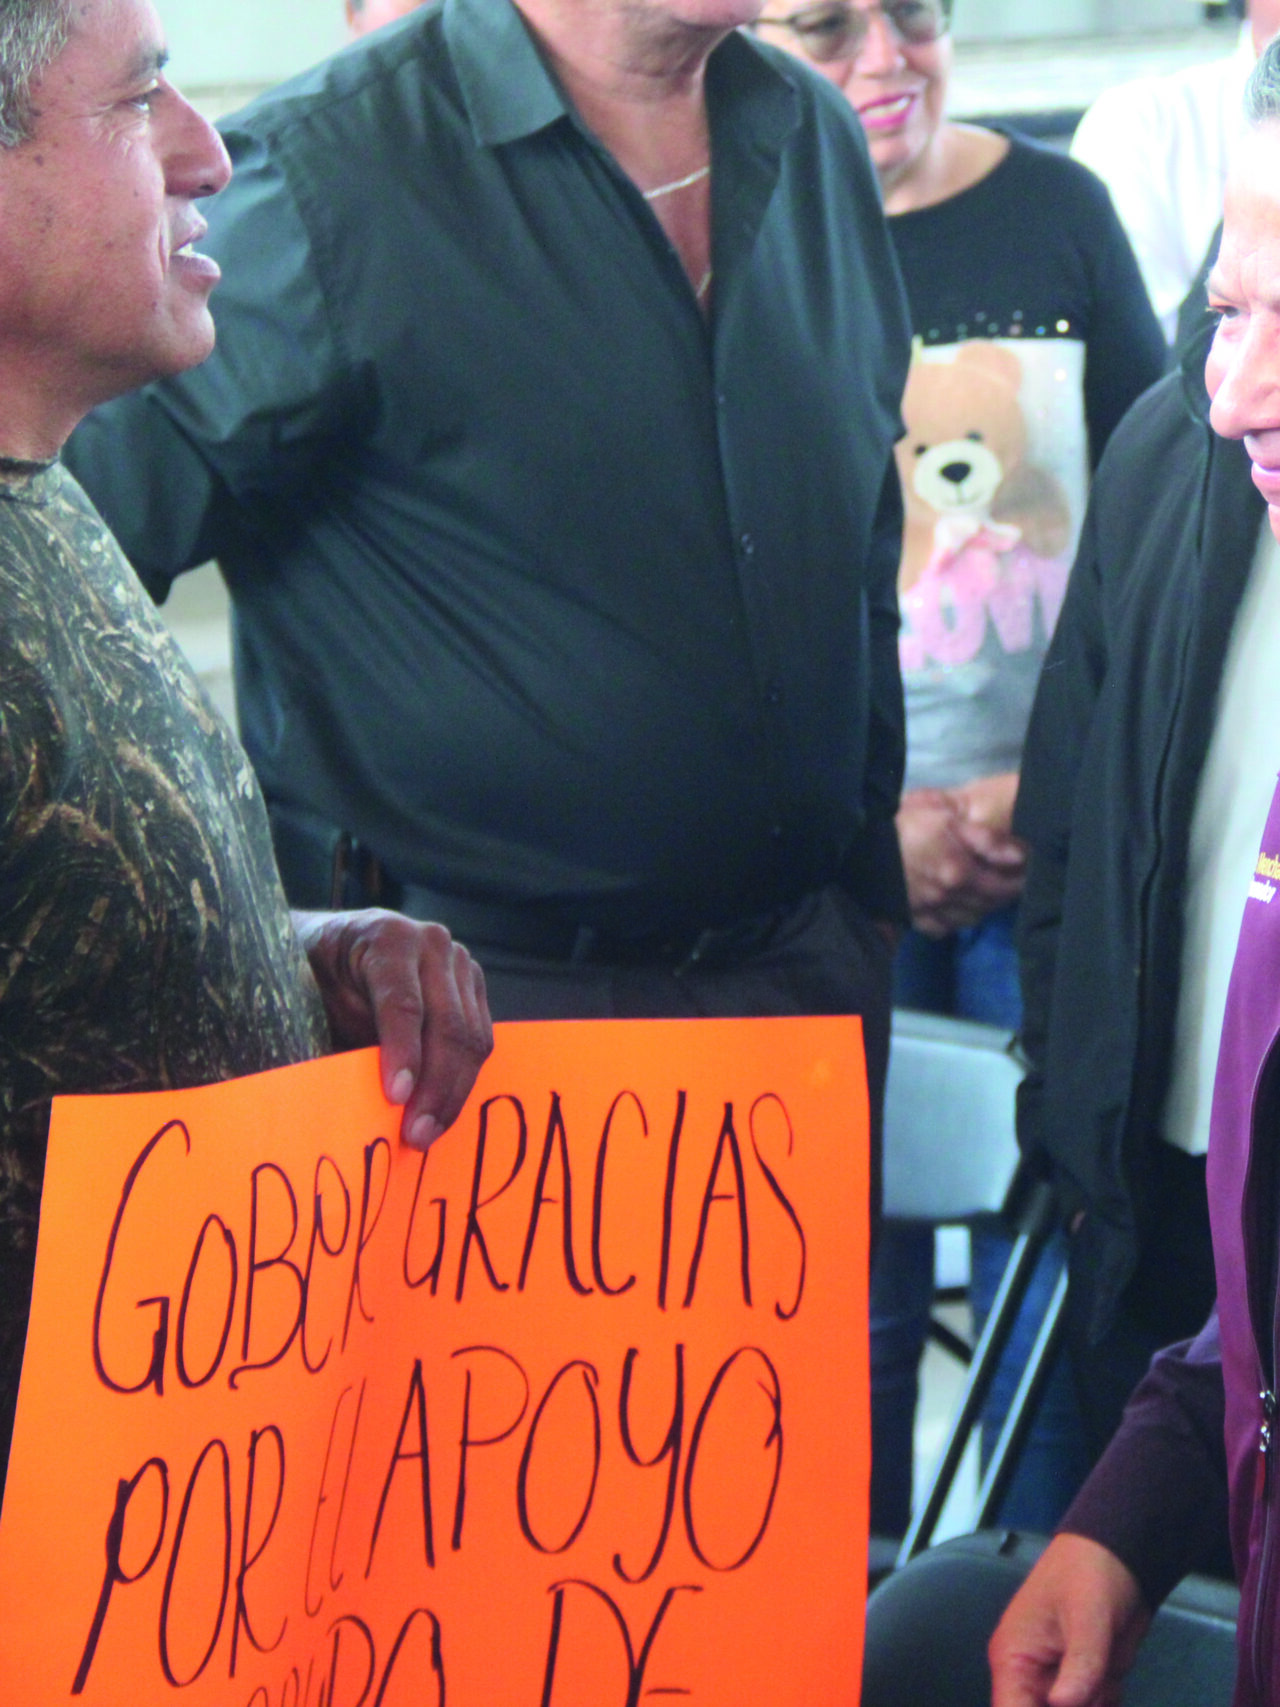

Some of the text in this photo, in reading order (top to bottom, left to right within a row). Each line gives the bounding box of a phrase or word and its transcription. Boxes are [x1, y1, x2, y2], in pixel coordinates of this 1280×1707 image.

[402, 1090, 806, 1321] GRACIAS
[71, 1425, 288, 1695] POR
[364, 1344, 784, 1584] APOYO
